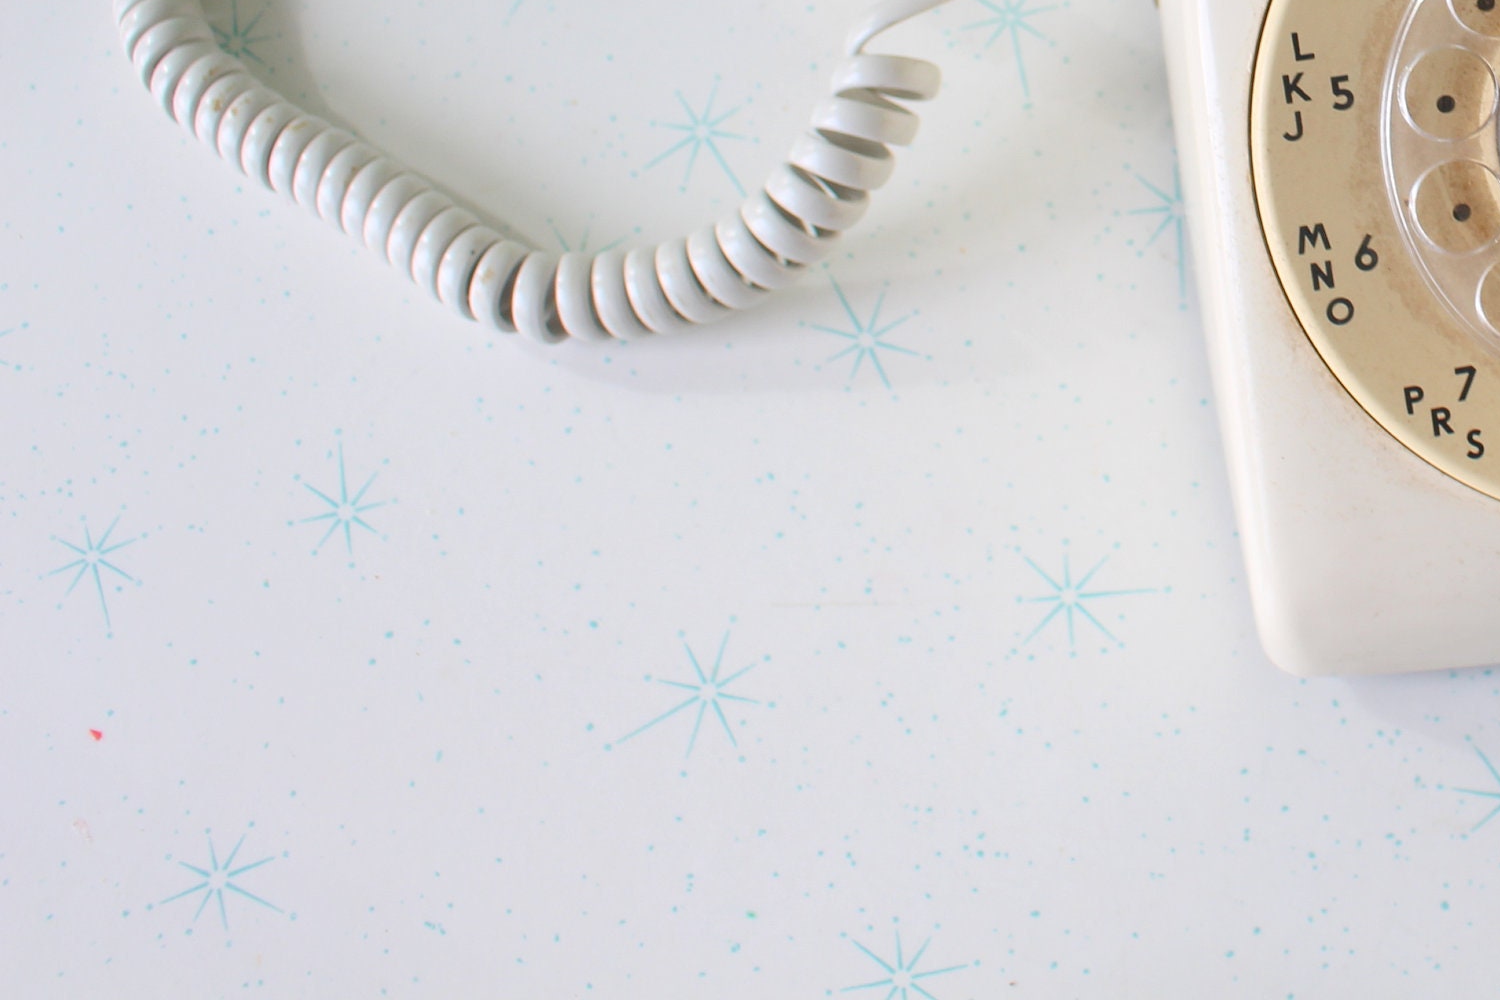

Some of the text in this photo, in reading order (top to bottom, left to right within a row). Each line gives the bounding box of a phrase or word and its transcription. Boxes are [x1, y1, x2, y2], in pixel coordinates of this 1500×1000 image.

[1330, 74, 1356, 111] 5
[1354, 233, 1380, 273] 6
[1297, 222, 1356, 327] MNO
[1453, 365, 1478, 402] 7
[1403, 384, 1486, 461] PRS
